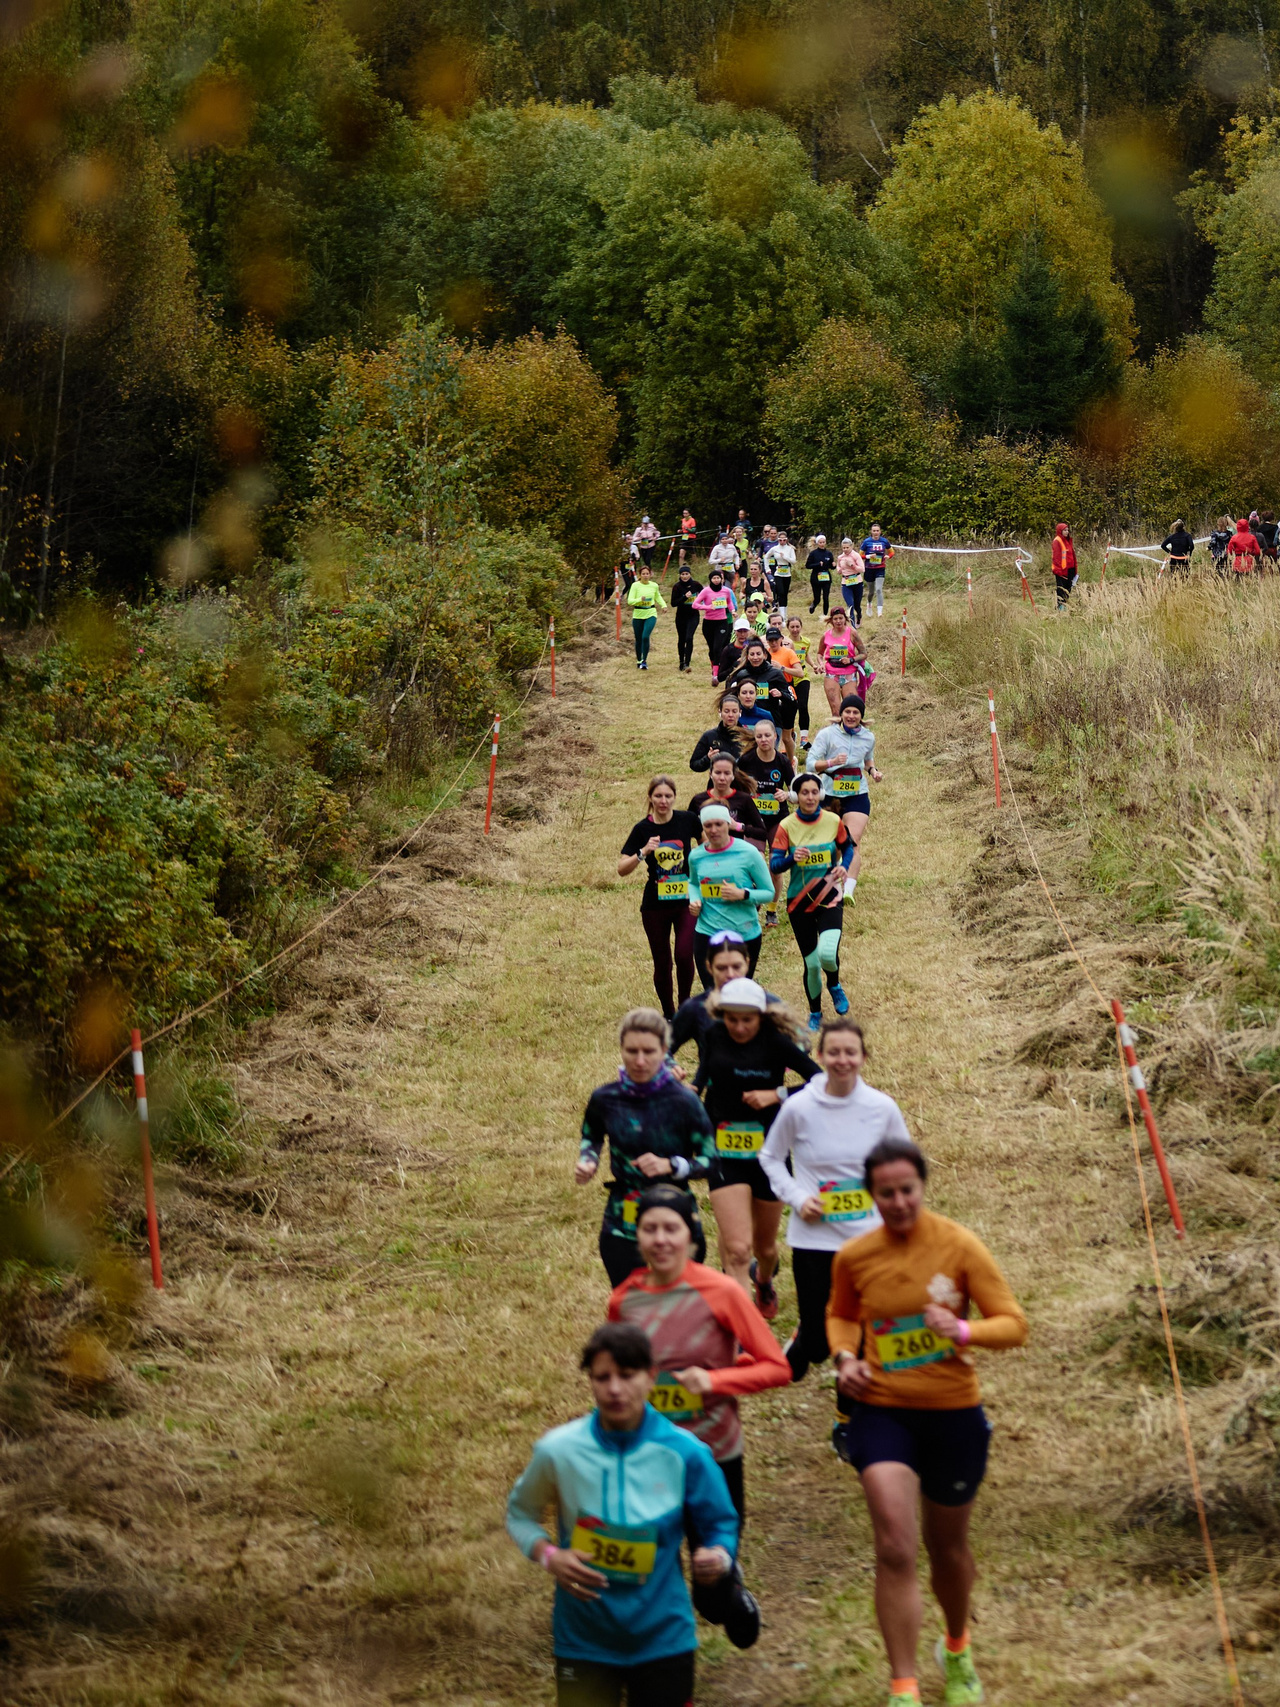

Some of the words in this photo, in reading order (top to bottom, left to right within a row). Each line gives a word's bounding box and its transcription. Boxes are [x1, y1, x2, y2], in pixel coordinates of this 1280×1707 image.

[840, 782, 854, 790] 284
[756, 801, 772, 810] 354
[804, 854, 824, 864] 288
[665, 884, 684, 893] 392
[708, 886, 720, 896] 17
[724, 1134, 753, 1149] 328
[831, 1194, 864, 1211] 253
[891, 1331, 936, 1357] 260
[590, 1538, 636, 1569] 384
